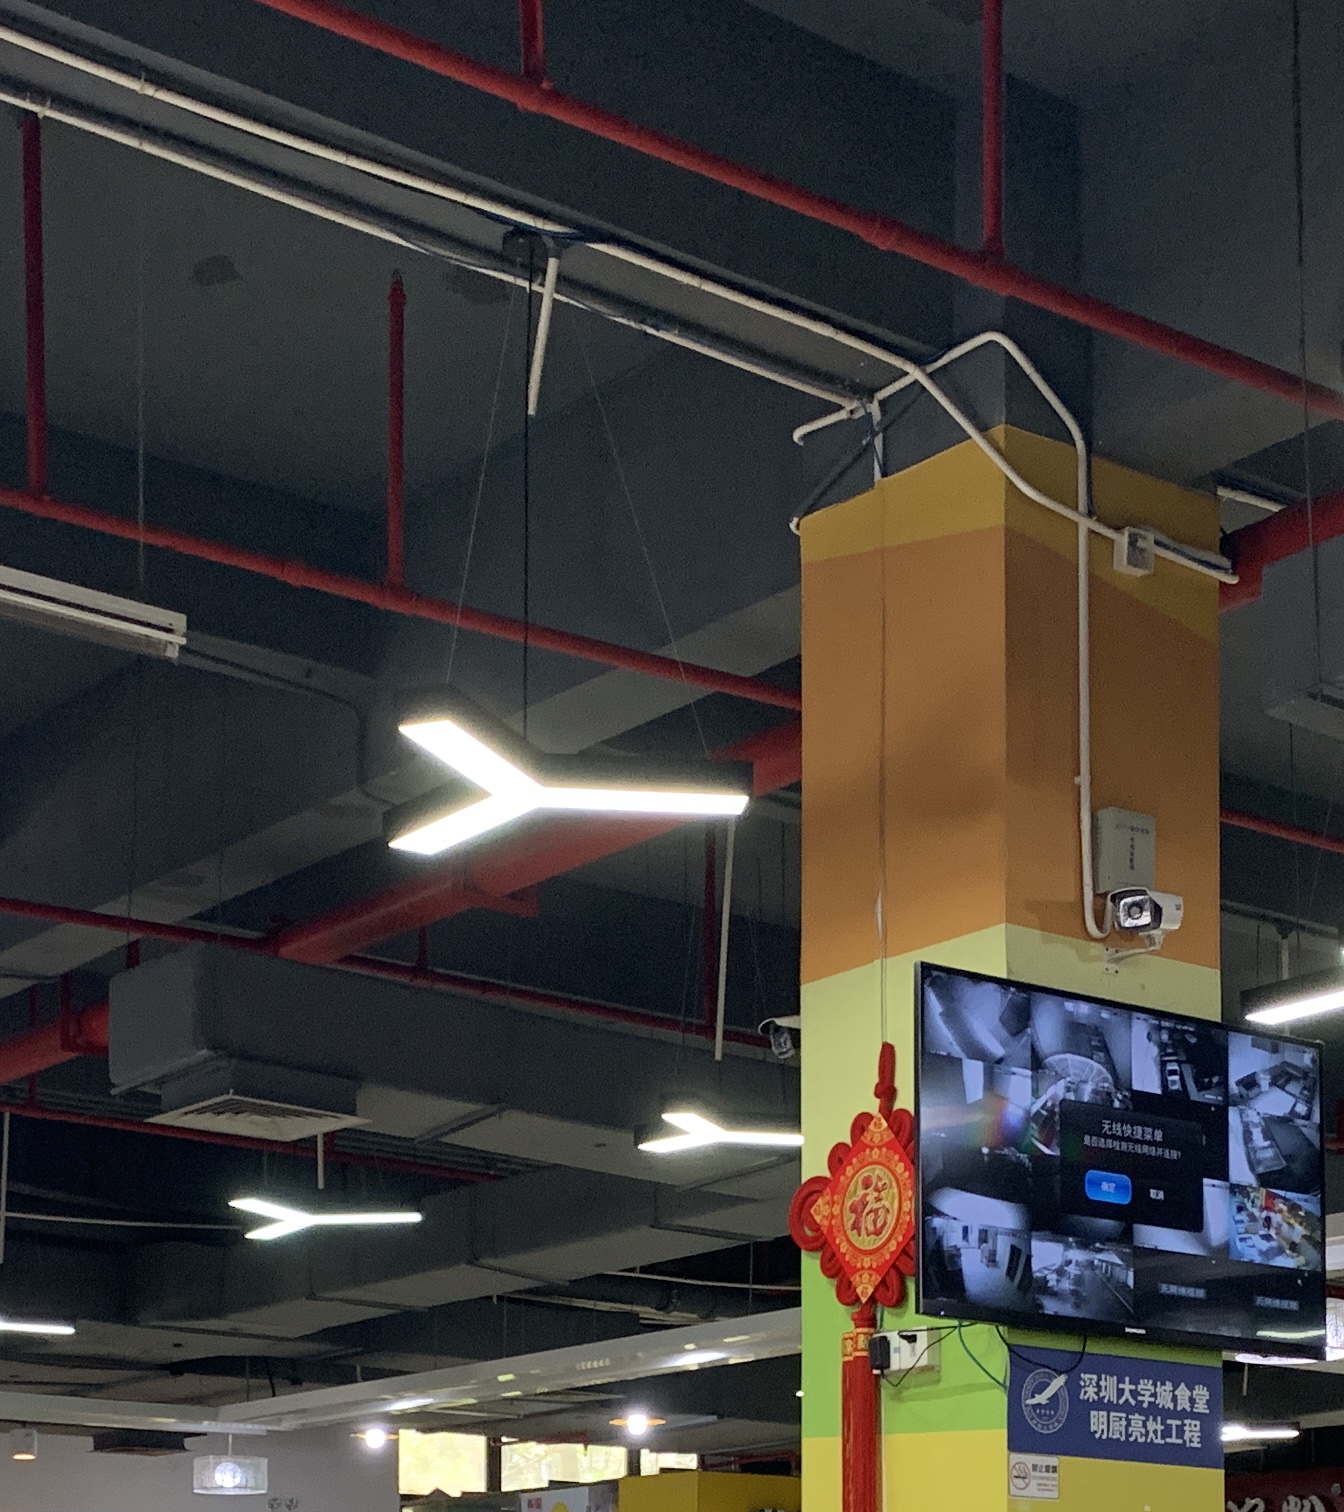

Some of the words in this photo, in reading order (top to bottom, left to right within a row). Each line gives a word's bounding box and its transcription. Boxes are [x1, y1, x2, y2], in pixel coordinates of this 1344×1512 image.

[1079, 1372, 1210, 1414] 深圳大学城食堂
[1089, 1410, 1202, 1448] 明厨亮灶工程
